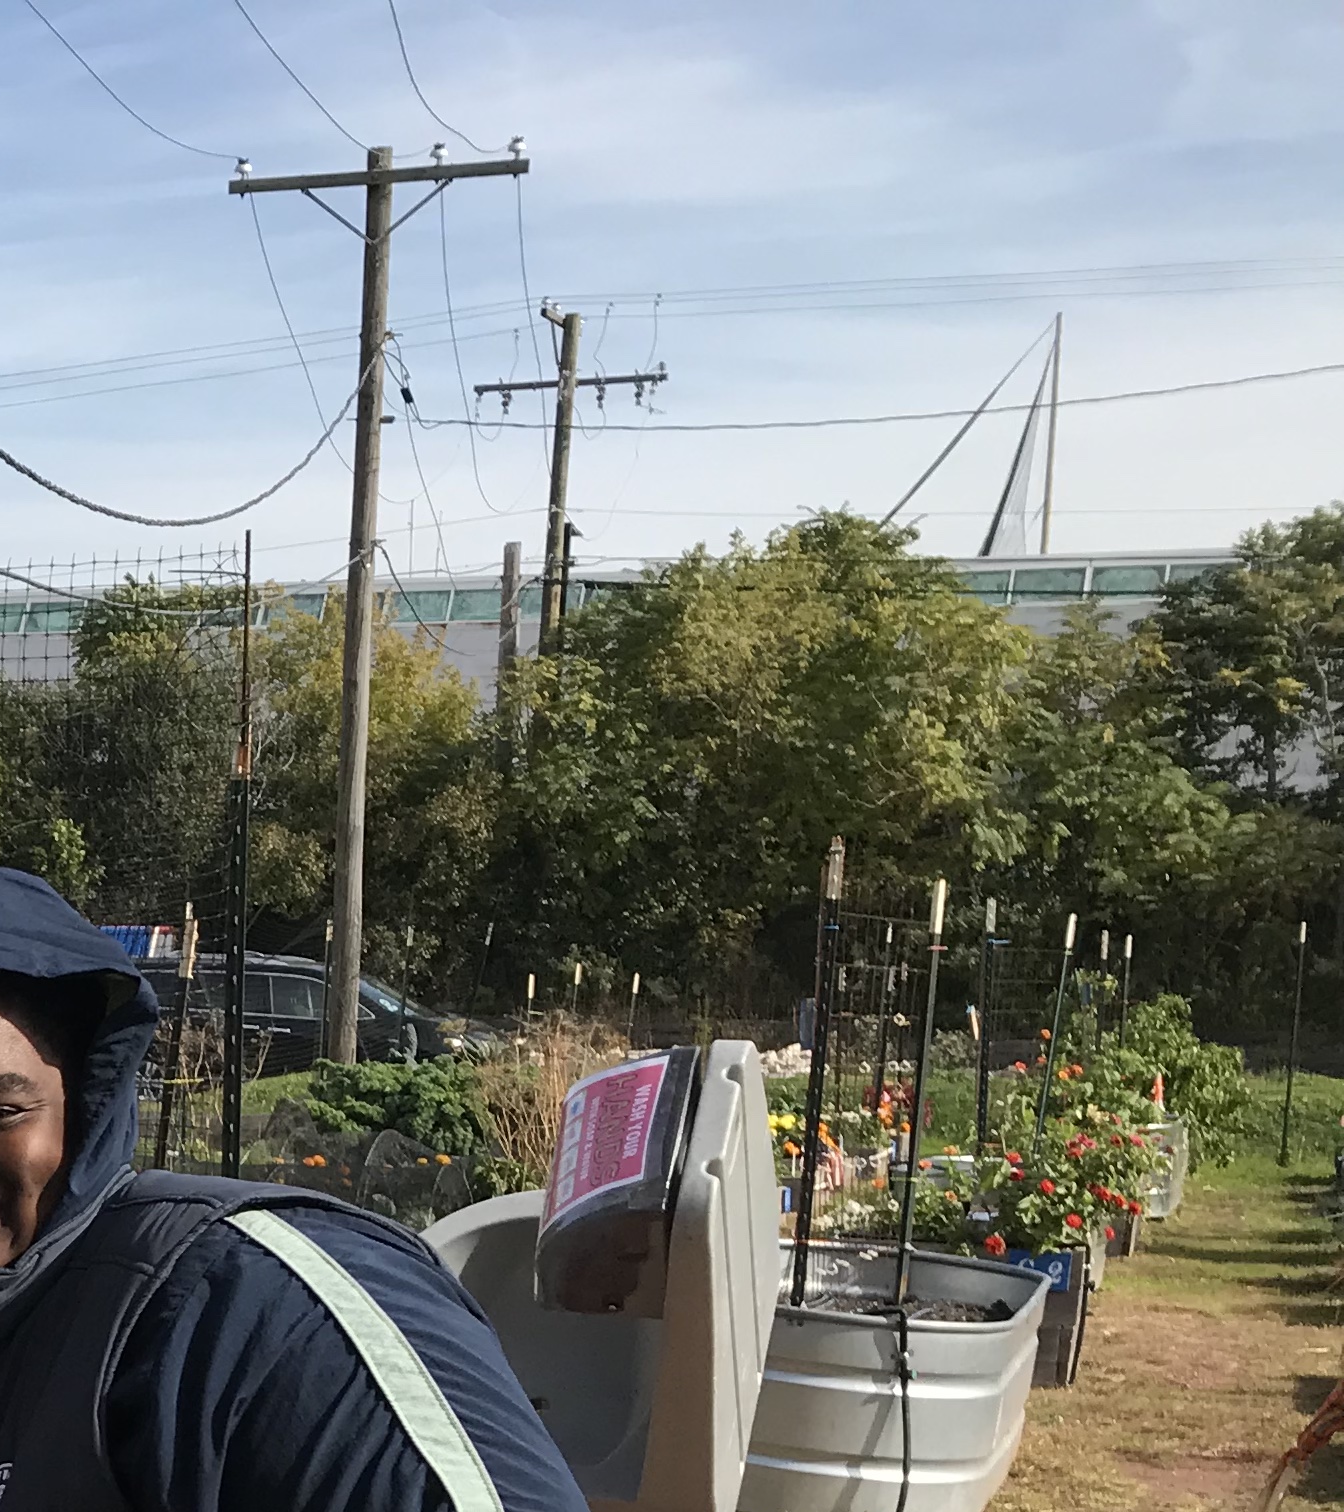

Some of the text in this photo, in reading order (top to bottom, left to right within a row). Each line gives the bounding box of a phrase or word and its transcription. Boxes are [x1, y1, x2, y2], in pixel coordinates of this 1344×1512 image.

[590, 1073, 638, 1188] HANDS
[623, 1084, 652, 1159] WASH YOUR
